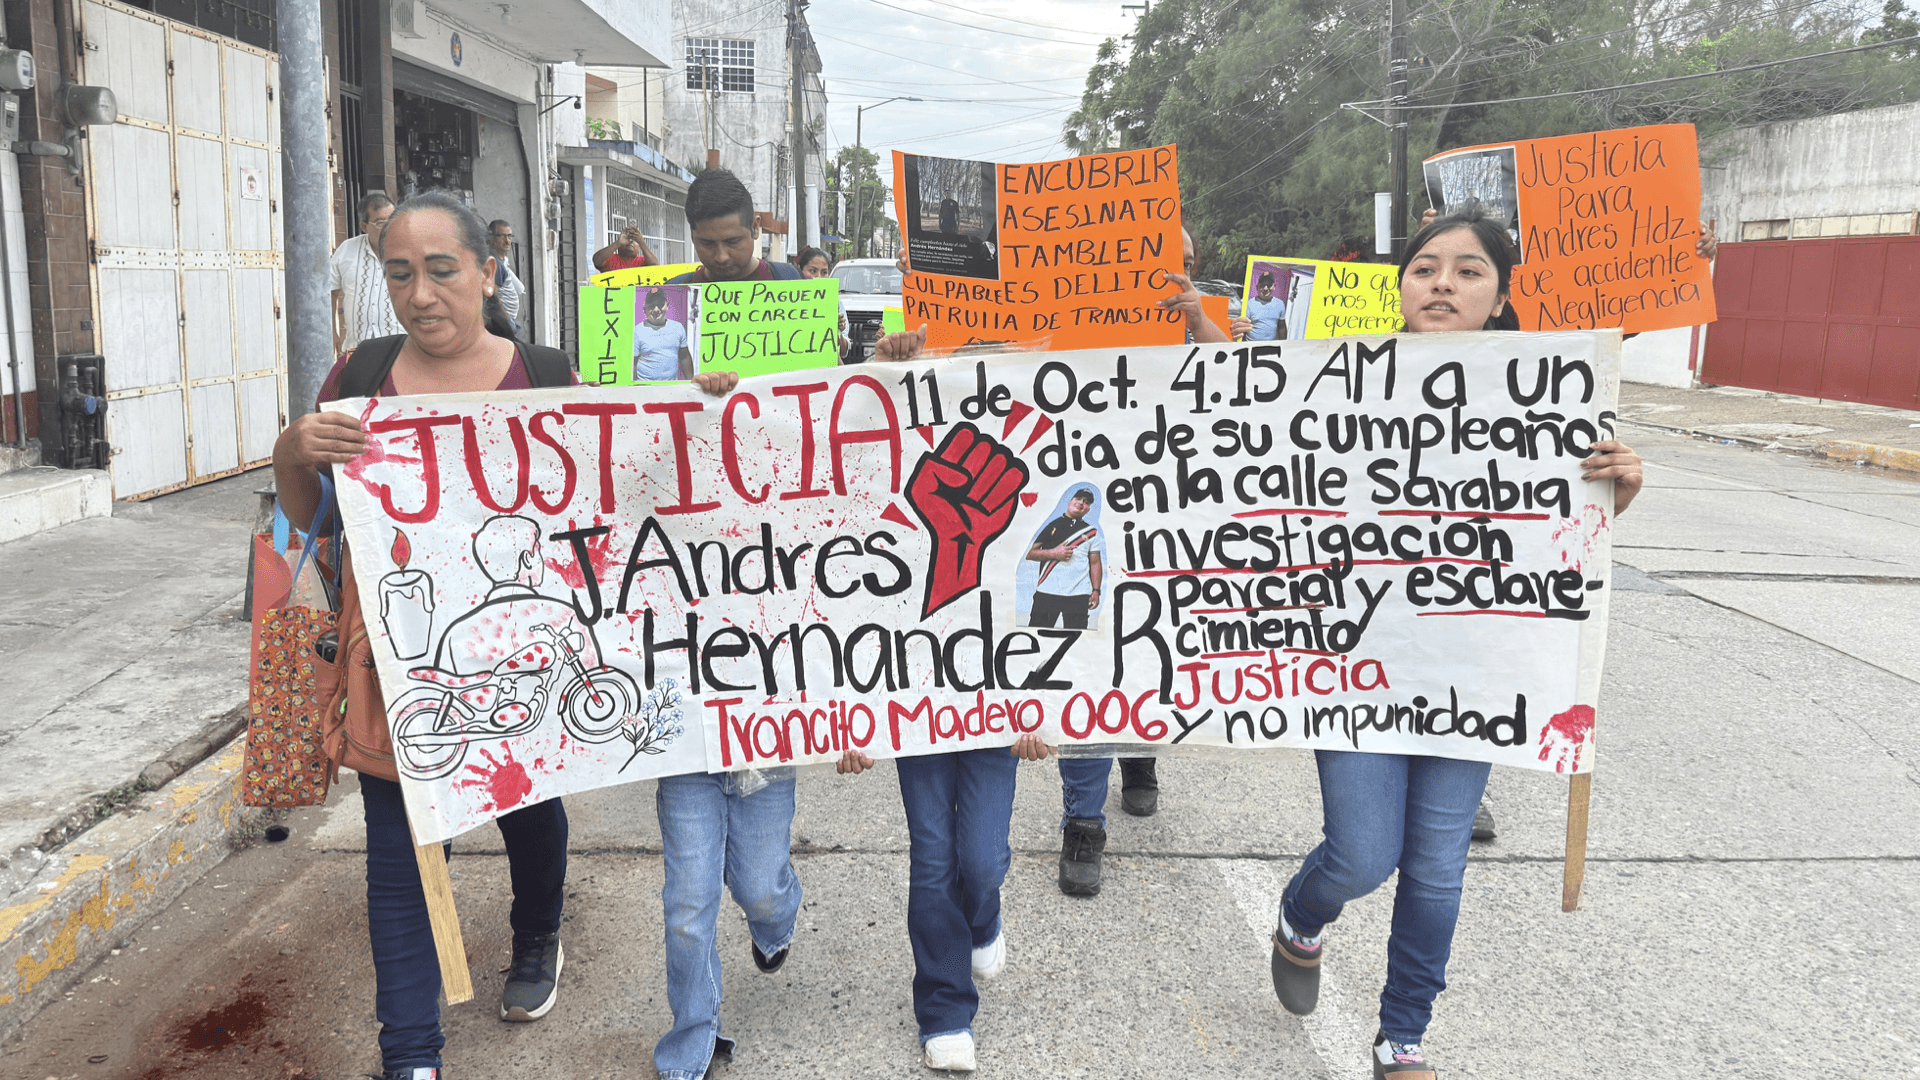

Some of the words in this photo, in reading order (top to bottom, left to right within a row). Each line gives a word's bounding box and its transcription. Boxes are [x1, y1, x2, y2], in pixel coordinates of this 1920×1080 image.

[1004, 147, 1173, 195] ENCUBRIR
[1003, 197, 1177, 232] ASESINATO
[1524, 218, 1619, 265] Andres
[1632, 205, 1696, 248] Hdz.
[1003, 232, 1164, 268] TAMBIEN
[1054, 268, 1170, 300] DELITO
[1323, 294, 1367, 310] mos
[1328, 267, 1359, 290] No
[706, 311, 741, 324] CON
[748, 308, 826, 322] CARCEL
[1033, 311, 1062, 331] DE
[1070, 306, 1182, 327] TRANSITO
[1538, 279, 1701, 332] Negligencia
[701, 327, 837, 363] JUSTICIA
[899, 368, 948, 430] 11
[960, 362, 1012, 420] de
[1033, 354, 1137, 413] Oct.
[1171, 345, 1288, 413] 4:15
[1302, 338, 1398, 405] AM
[1421, 361, 1468, 409] a
[370, 374, 901, 524] JUSTICIA
[1037, 419, 1119, 477] dia
[1135, 405, 1196, 465] de
[1211, 421, 1274, 458] su
[1233, 453, 1348, 508] calle
[1354, 577, 1393, 634] y
[642, 590, 1083, 695] Hernandez
[1112, 580, 1175, 705] R
[1176, 610, 1358, 658] cimiento
[887, 688, 1044, 752] Madero
[1171, 708, 1213, 744] y
[1224, 705, 1288, 743] no
